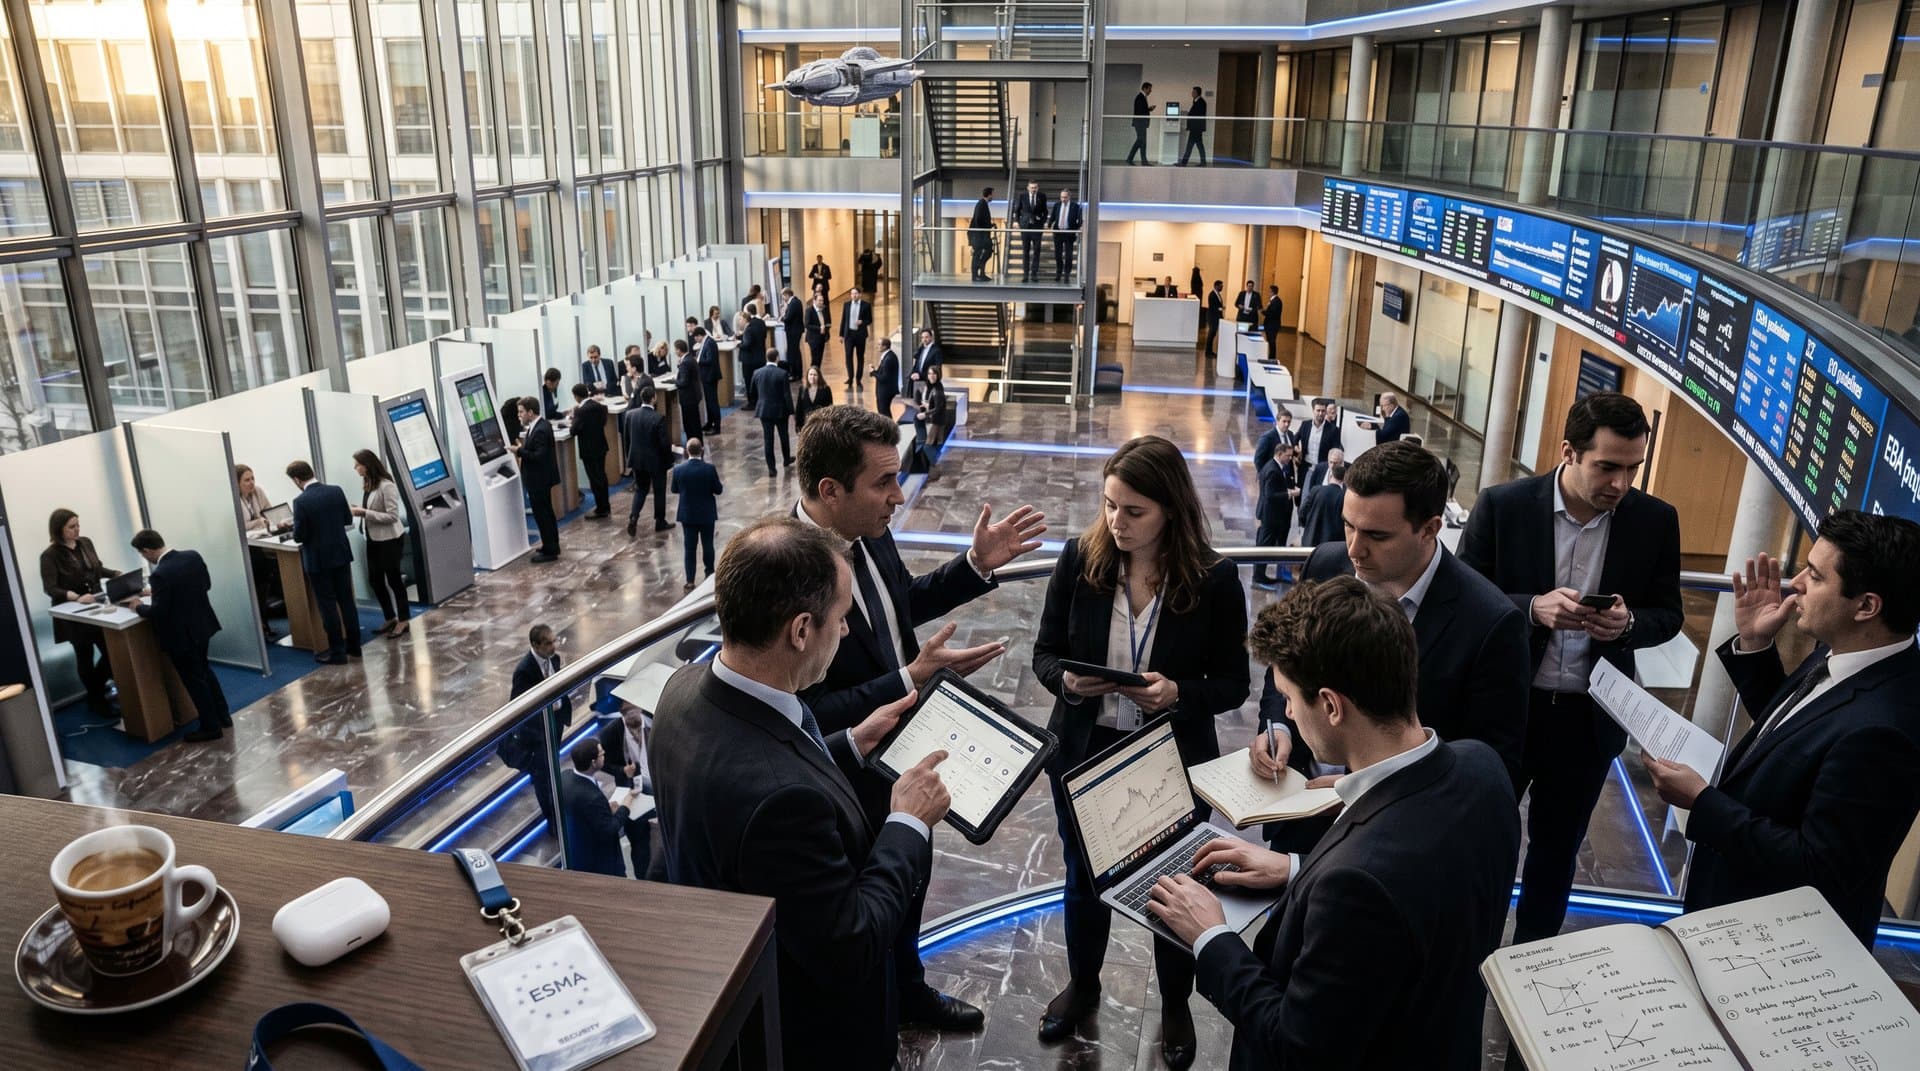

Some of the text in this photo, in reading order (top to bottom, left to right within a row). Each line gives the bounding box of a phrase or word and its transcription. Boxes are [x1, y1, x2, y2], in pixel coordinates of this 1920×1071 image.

[1883, 433, 1905, 476] EBA
[528, 971, 587, 1003] ESMA
[557, 1021, 601, 1046] SECURITY
